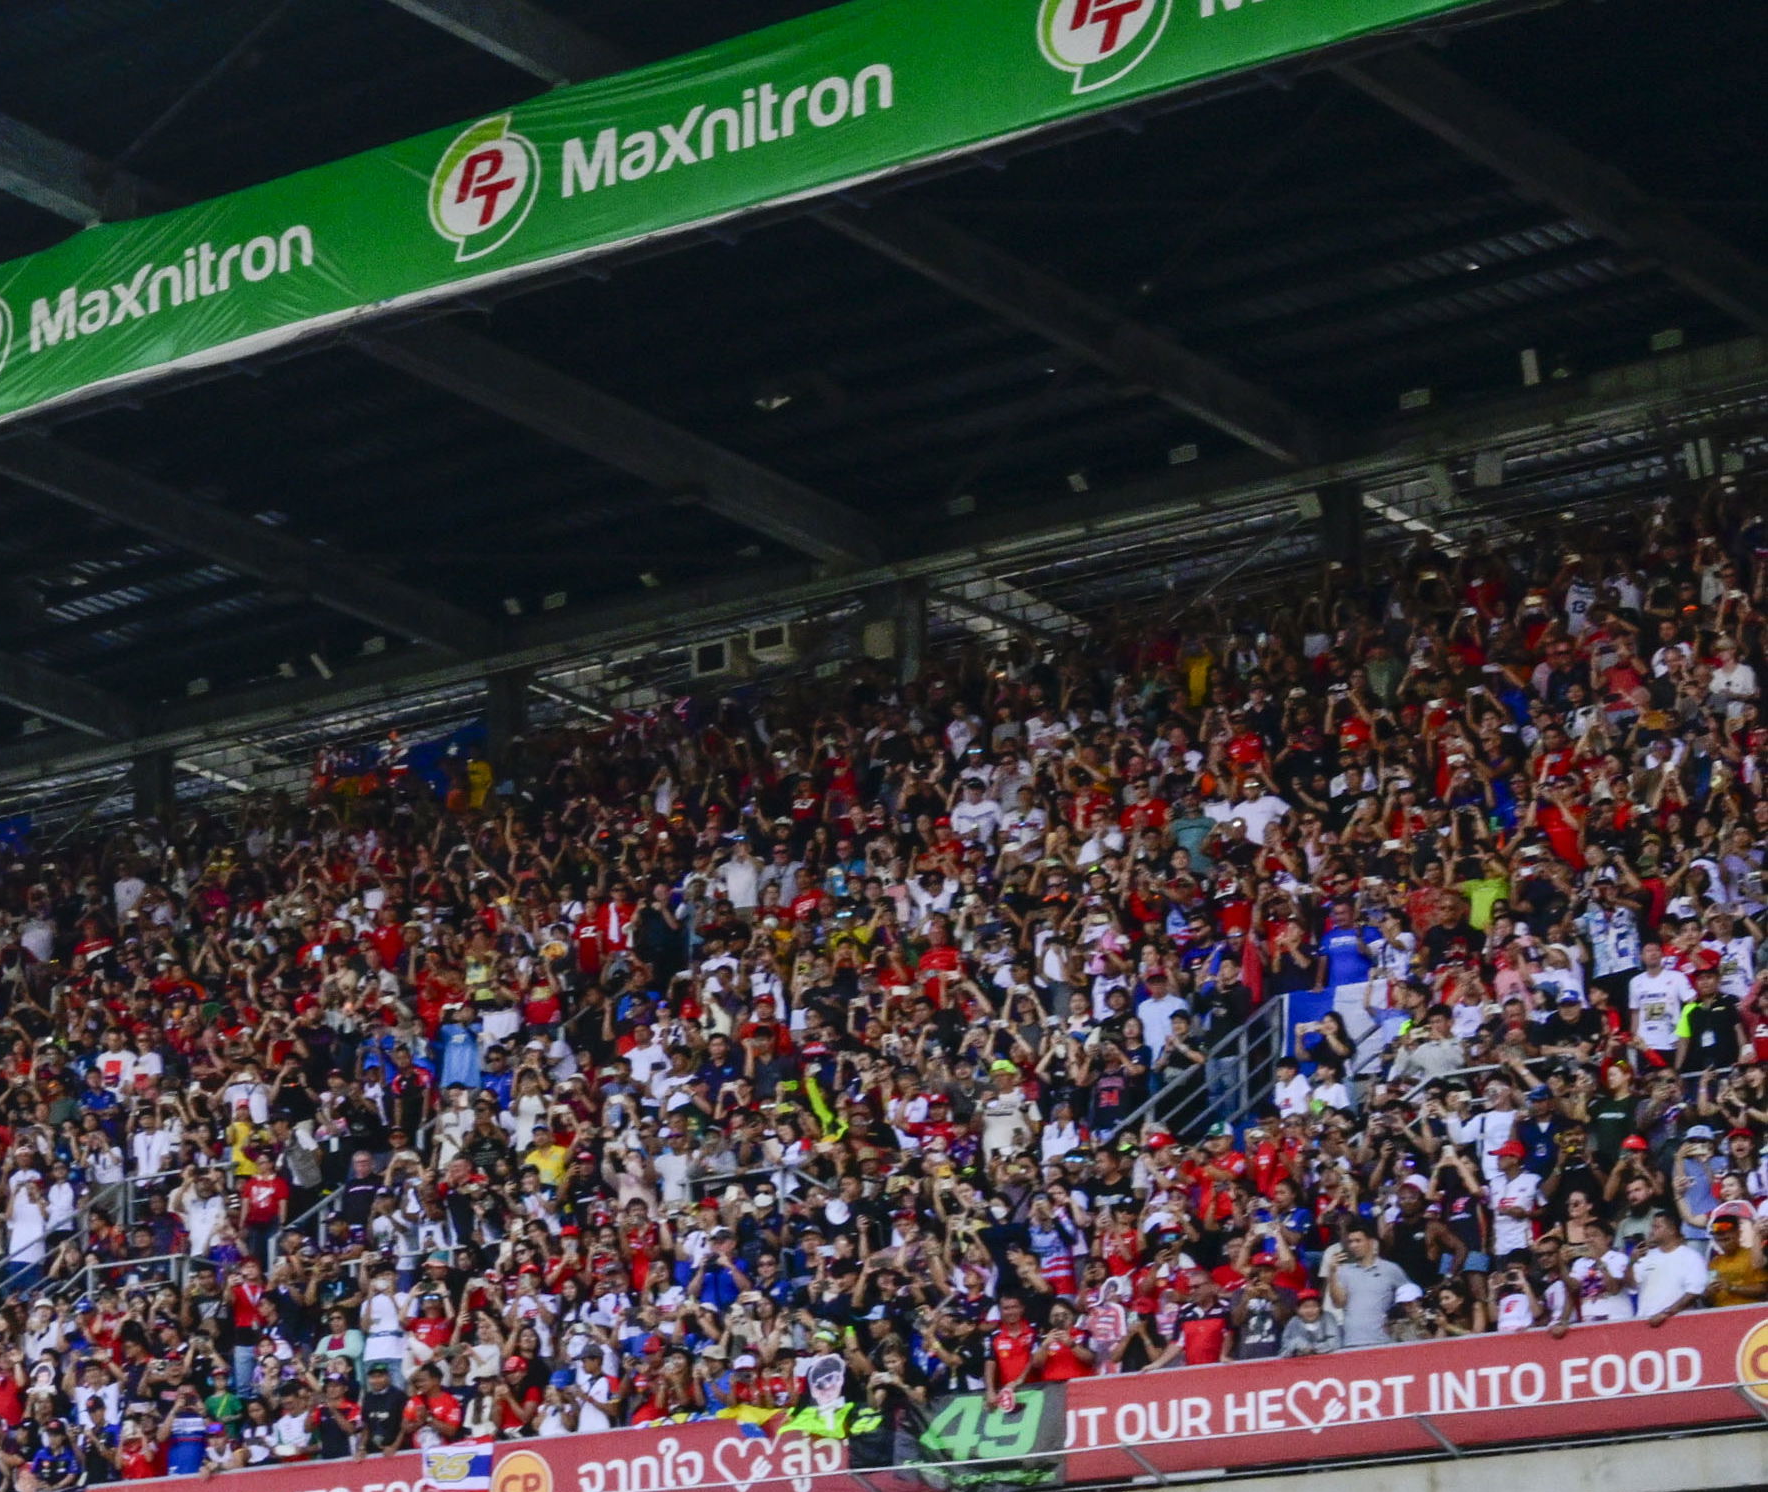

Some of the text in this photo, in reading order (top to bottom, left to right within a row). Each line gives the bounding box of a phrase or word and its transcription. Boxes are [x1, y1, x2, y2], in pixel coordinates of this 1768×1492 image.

[559, 62, 893, 198] Maxnitron
[28, 225, 314, 353] Maxnitron
[919, 1390, 1044, 1461] 49
[1117, 1399, 1209, 1442] OUR
[1430, 1364, 1546, 1413] INTO
[1562, 1347, 1703, 1401] FOOD
